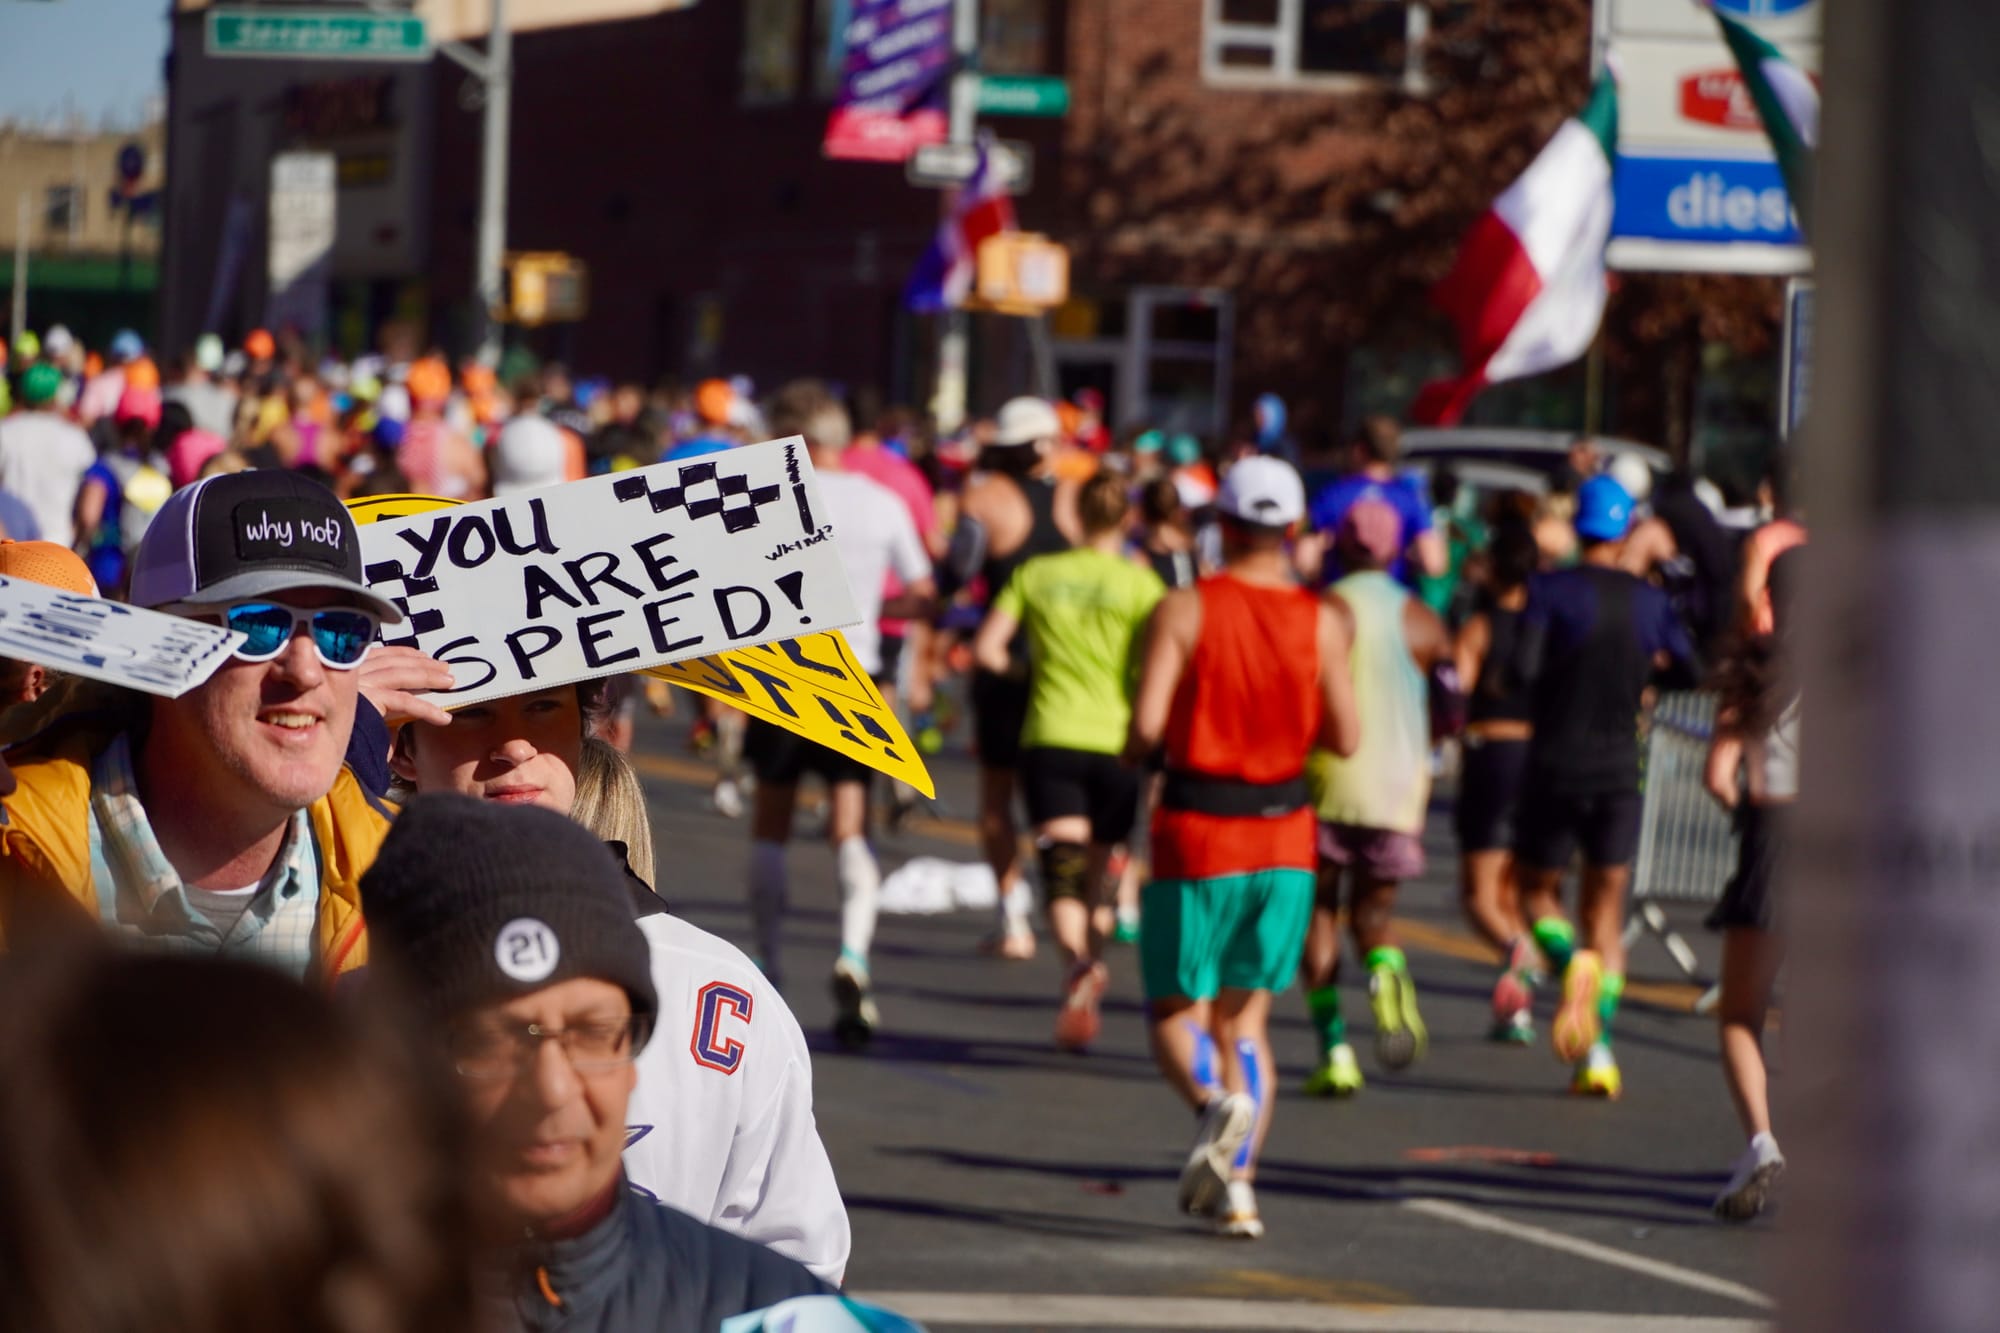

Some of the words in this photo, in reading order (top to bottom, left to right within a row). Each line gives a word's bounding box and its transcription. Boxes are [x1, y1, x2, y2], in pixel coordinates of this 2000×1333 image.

[1667, 171, 1800, 232] dies
[246, 509, 293, 547] why
[301, 516, 341, 550] not?
[396, 498, 560, 578] YOU
[524, 533, 699, 619] ARE
[431, 571, 812, 694] SPEED!
[507, 931, 549, 966] 21
[690, 980, 754, 1076] C
